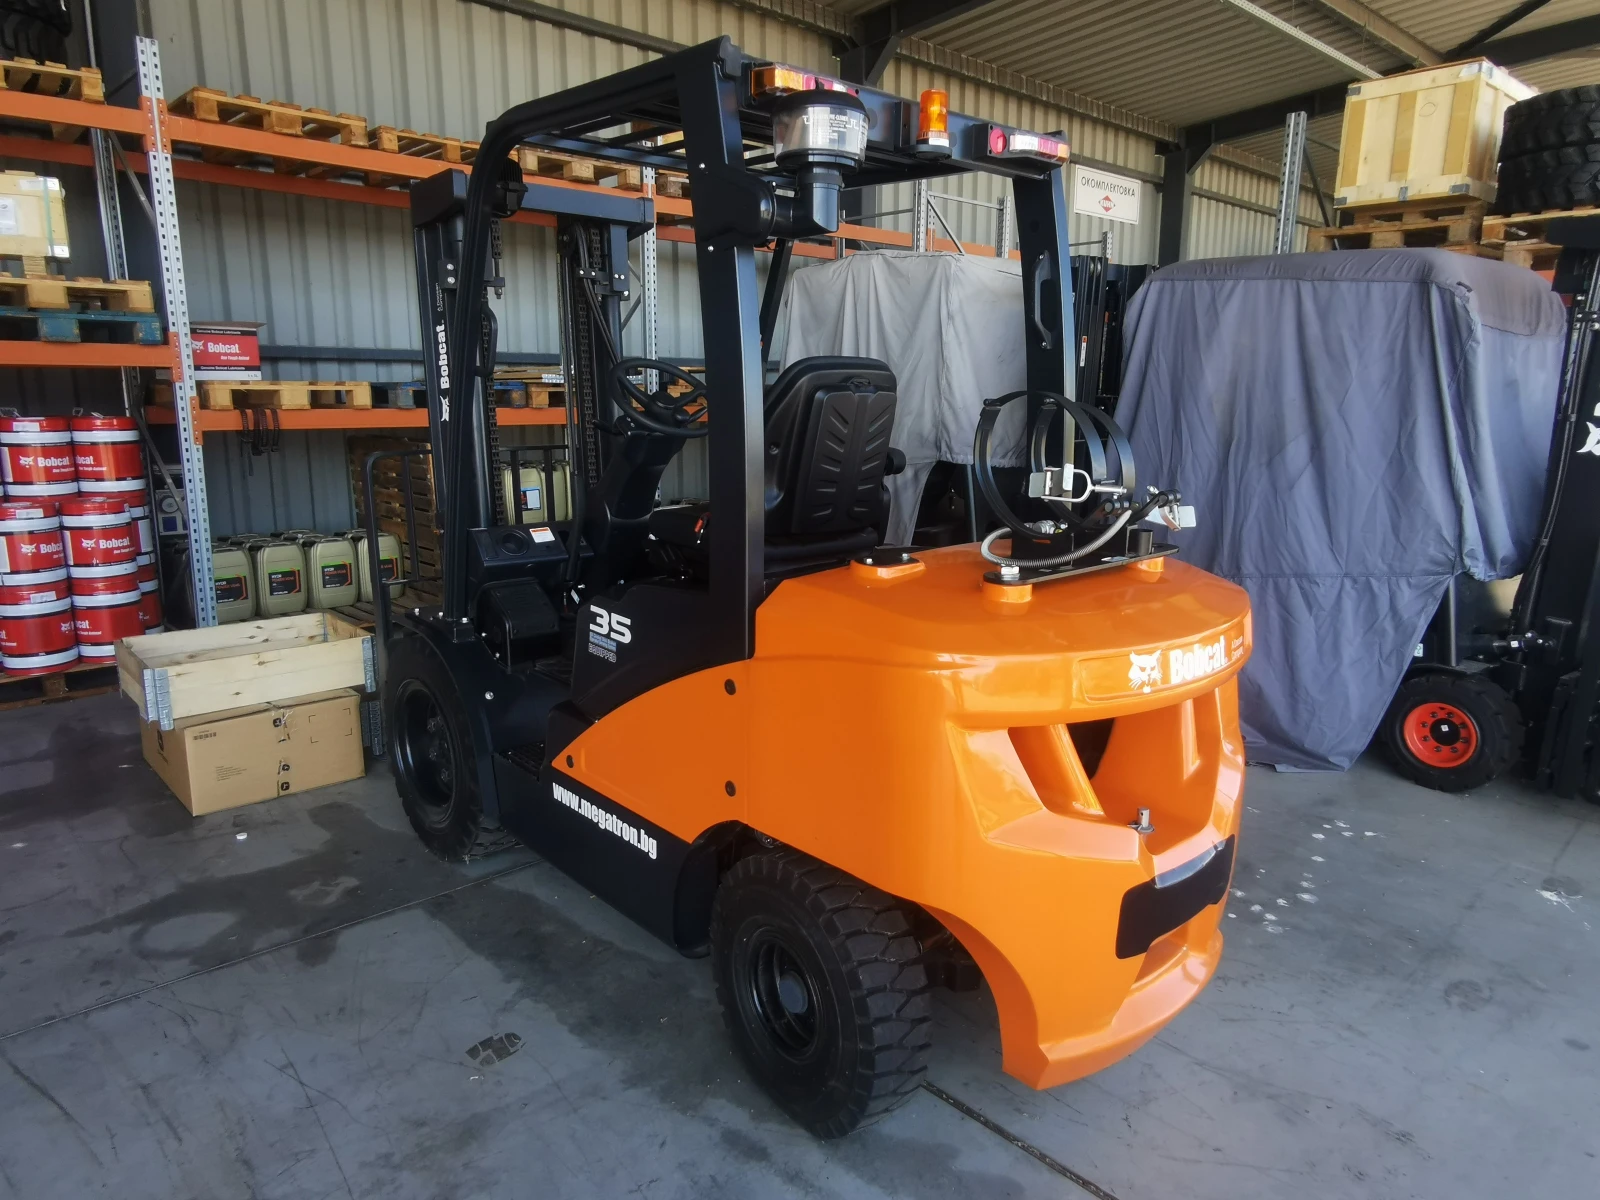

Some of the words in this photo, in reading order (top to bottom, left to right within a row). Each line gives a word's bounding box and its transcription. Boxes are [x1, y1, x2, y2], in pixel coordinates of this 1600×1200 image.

[1081, 176, 1135, 198] ОКОМПЛЕКТОВКА
[207, 342, 240, 354] Bobcat
[436, 324, 450, 389] Bobcat
[37, 456, 70, 467] Bobcat
[75, 455, 94, 465] bcat
[99, 536, 131, 549] Bobcat
[590, 604, 632, 644] 35
[588, 642, 617, 663] EQUIPPED
[1169, 635, 1226, 685] Bobcat
[552, 782, 657, 860] www.megatron.bg
